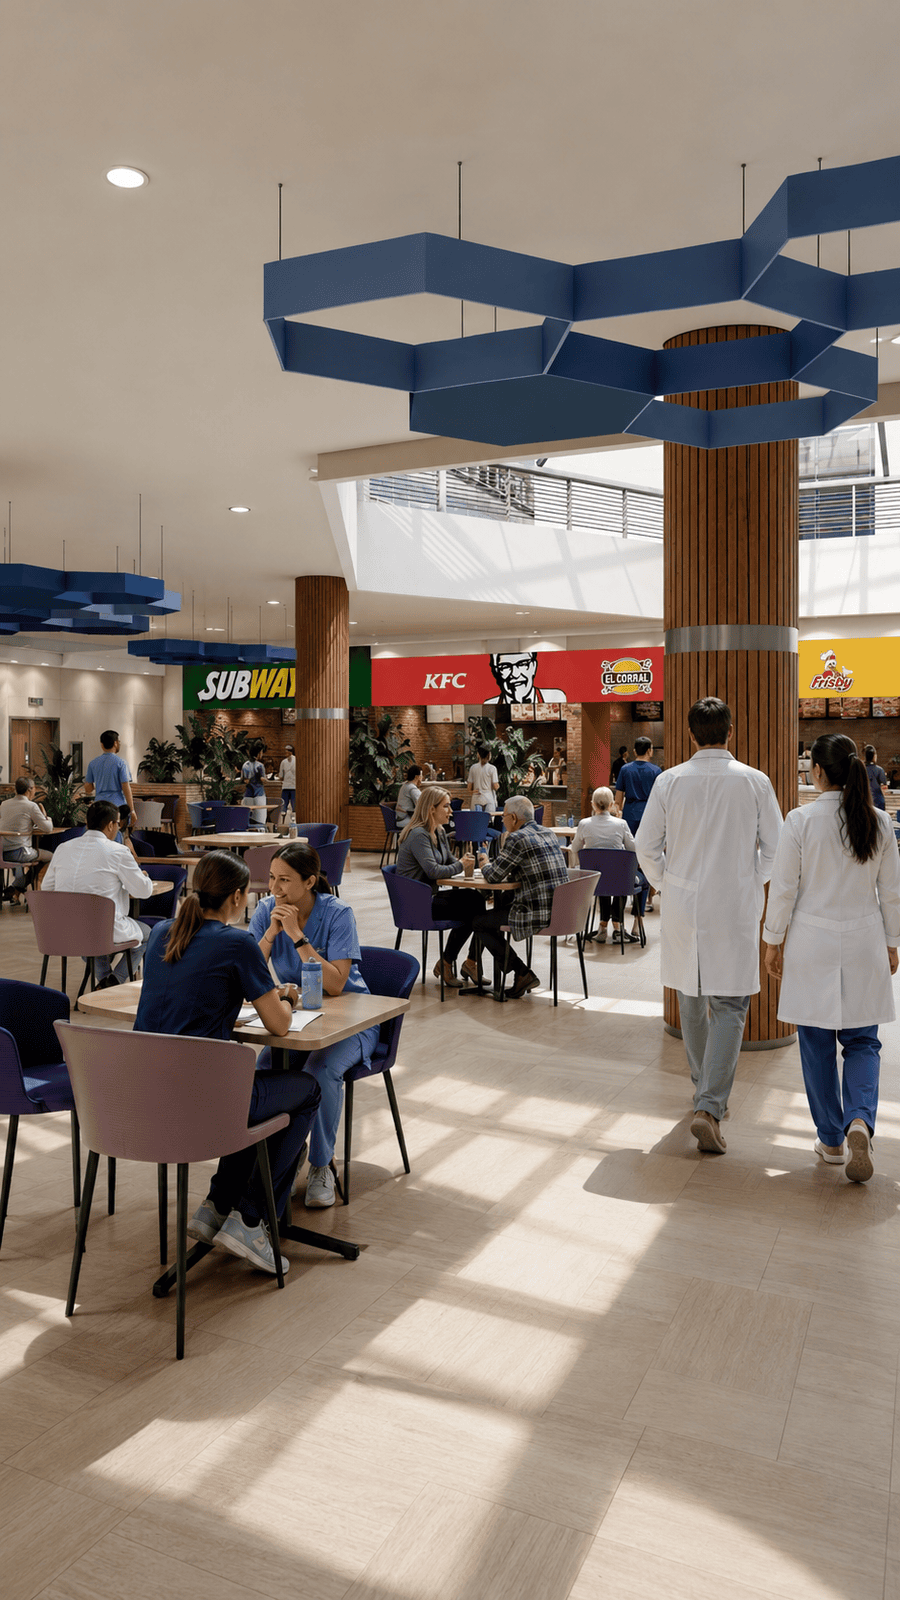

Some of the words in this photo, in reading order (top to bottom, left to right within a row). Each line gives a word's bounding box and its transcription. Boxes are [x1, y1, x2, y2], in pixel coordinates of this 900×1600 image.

[423, 672, 467, 689] KFC
[605, 674, 616, 684] EL
[617, 673, 650, 683] CORRAL
[810, 675, 854, 692] Frisby
